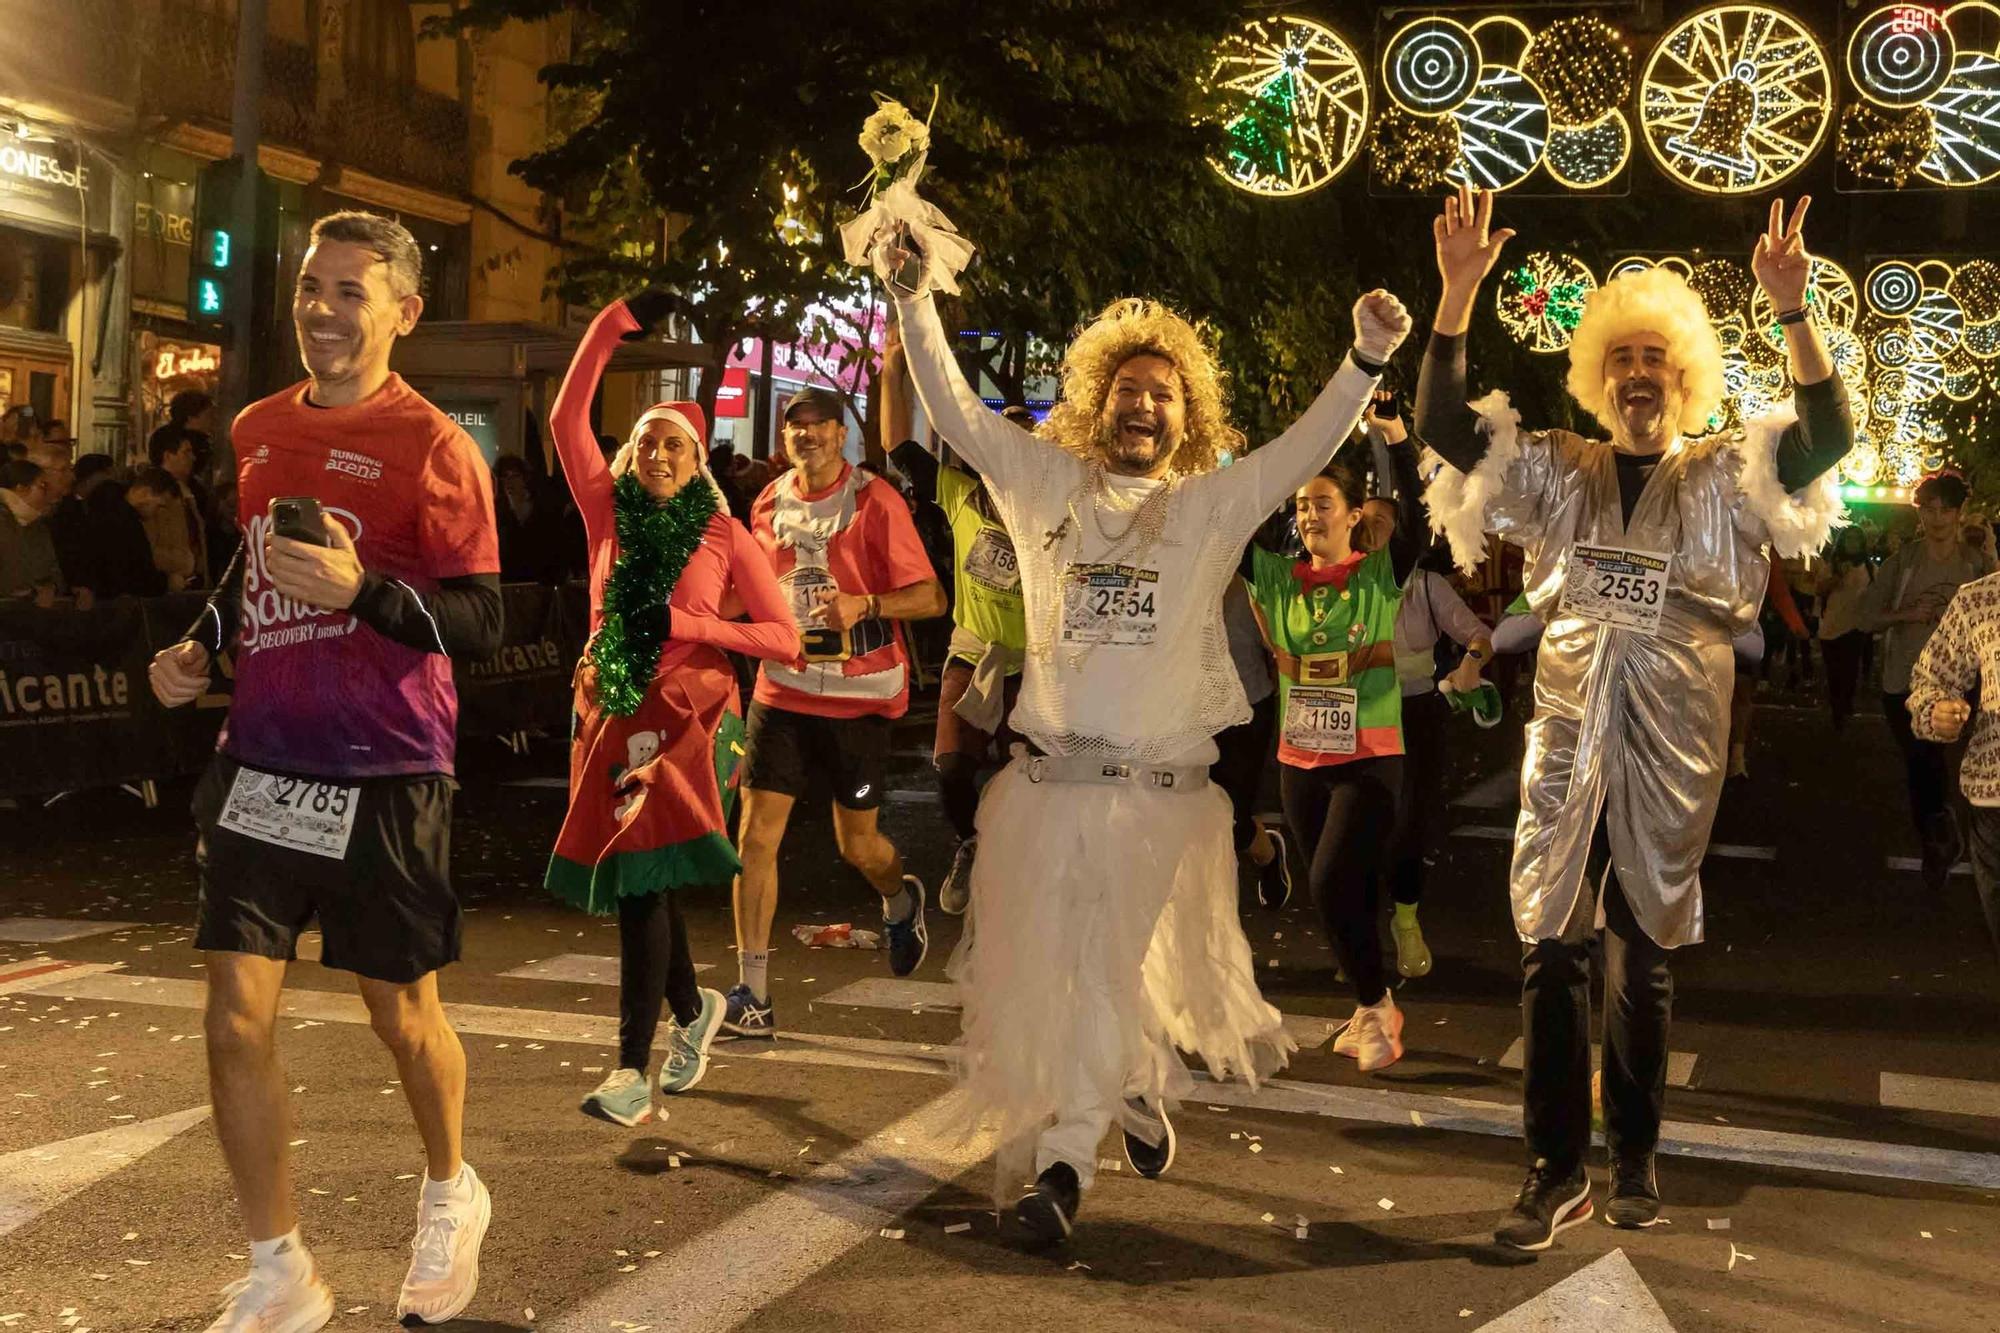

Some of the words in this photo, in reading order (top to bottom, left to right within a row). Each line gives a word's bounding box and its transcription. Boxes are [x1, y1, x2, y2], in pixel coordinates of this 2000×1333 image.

[215, 230, 230, 268] 3
[774, 345, 840, 379] SUERMARKET
[325, 458, 382, 480] arena
[330, 448, 384, 468] RUNNING
[1096, 589, 1156, 618] 2554
[1599, 575, 1660, 605] 2553
[260, 623, 317, 649] RECOVERY
[317, 624, 345, 640] DRINK
[1311, 709, 1351, 731] 1199
[274, 777, 350, 817] 2785
